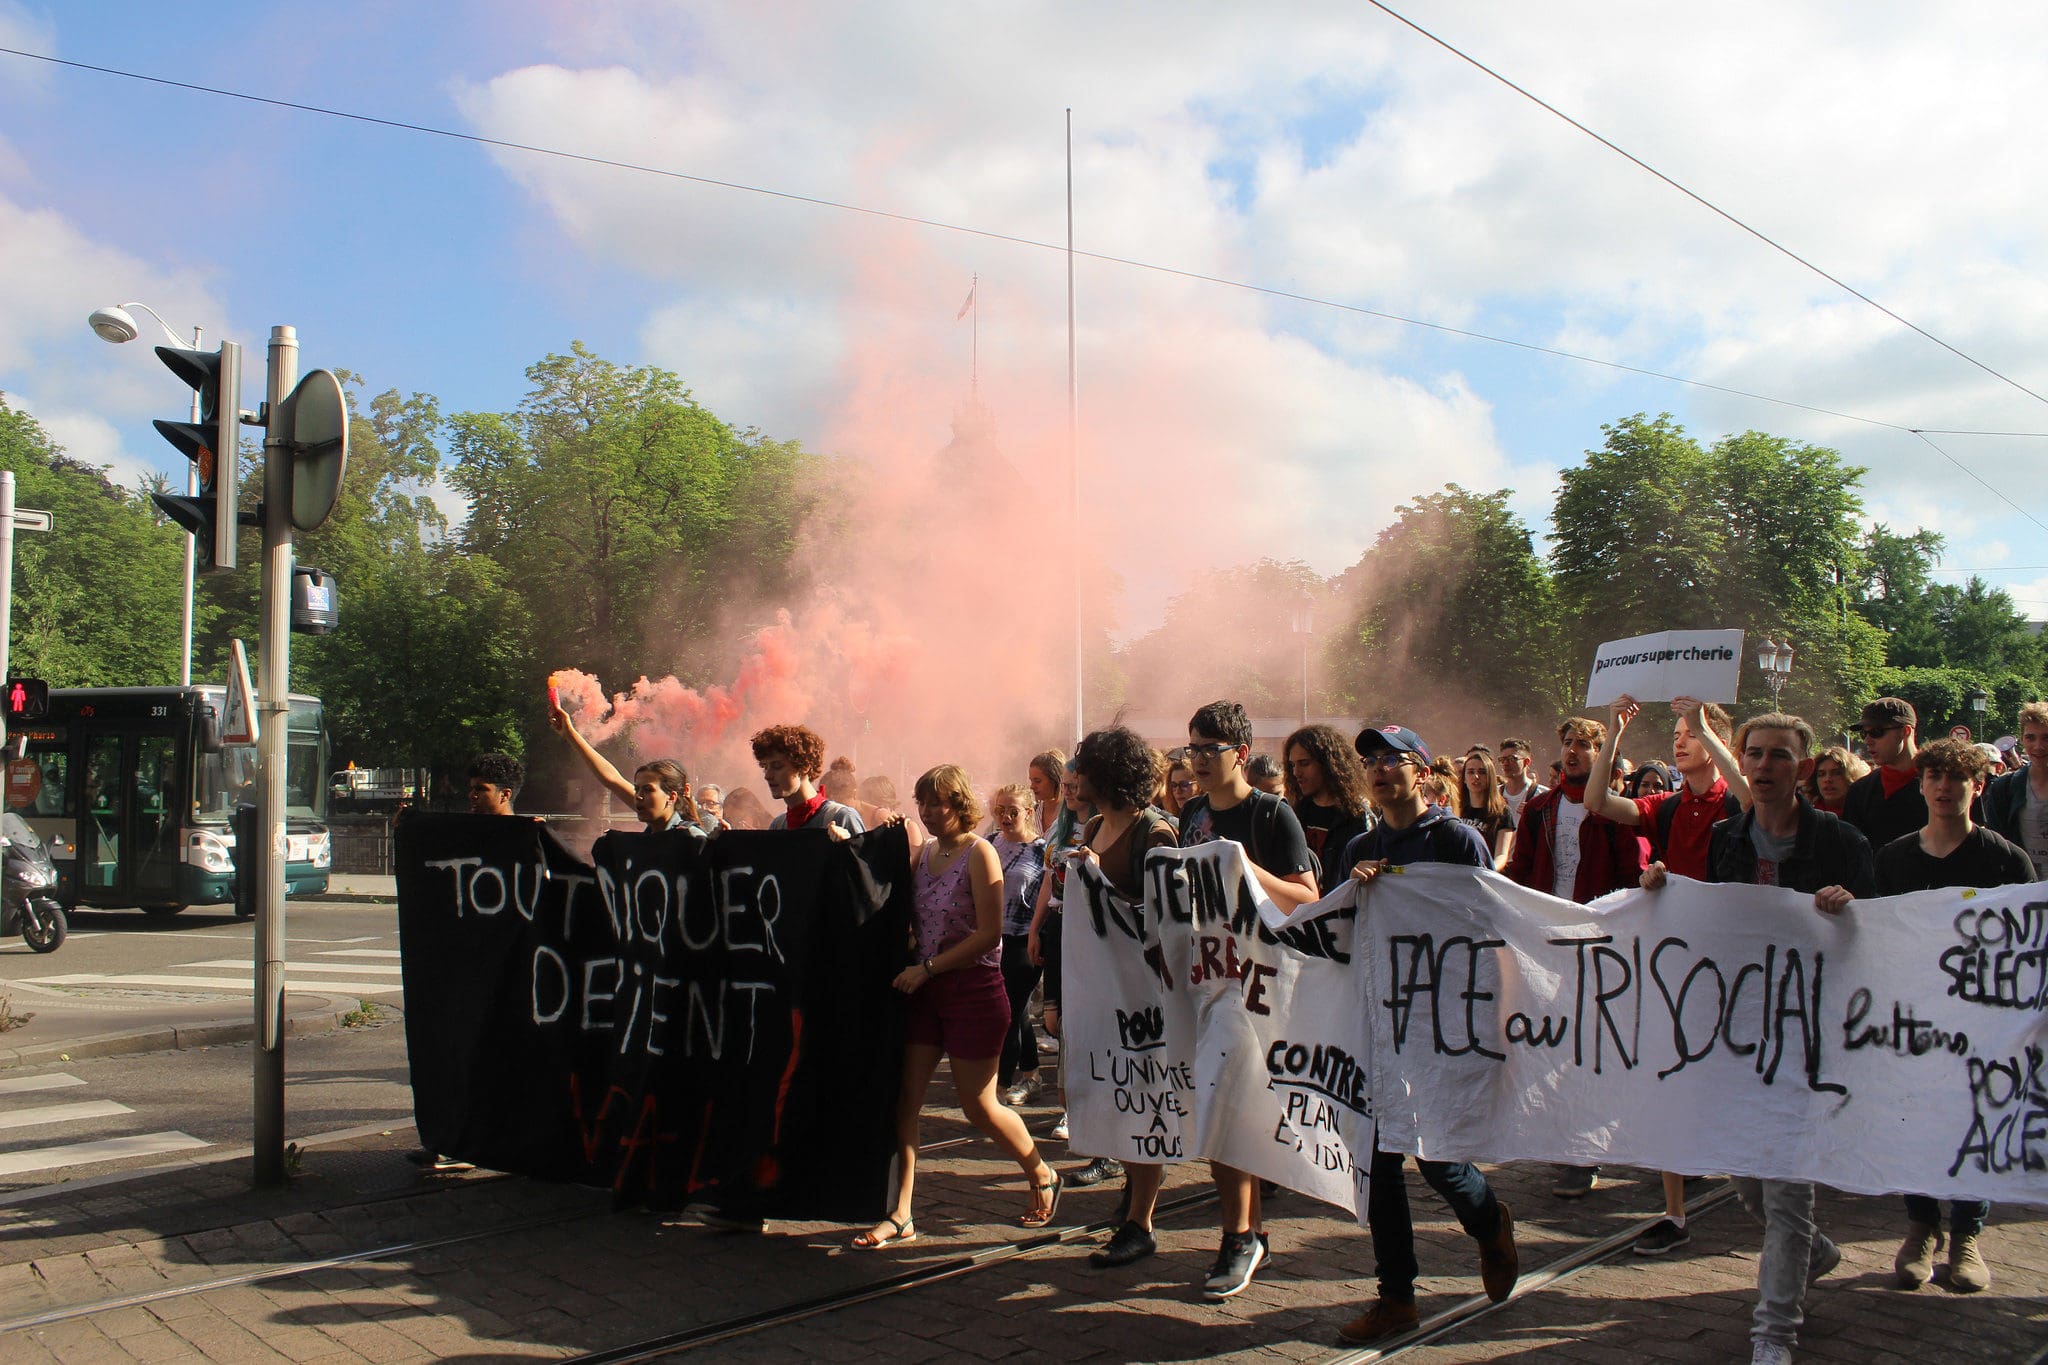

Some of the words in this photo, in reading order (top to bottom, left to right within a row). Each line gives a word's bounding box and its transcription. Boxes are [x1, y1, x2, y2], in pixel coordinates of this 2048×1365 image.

[1595, 646, 1734, 673] parcoursupercherie
[150, 706, 168, 717] 331
[425, 857, 596, 941] TOUT
[1383, 933, 1507, 1063] FACE
[1504, 1012, 1568, 1048] au
[1286, 1091, 1341, 1135] PLAN
